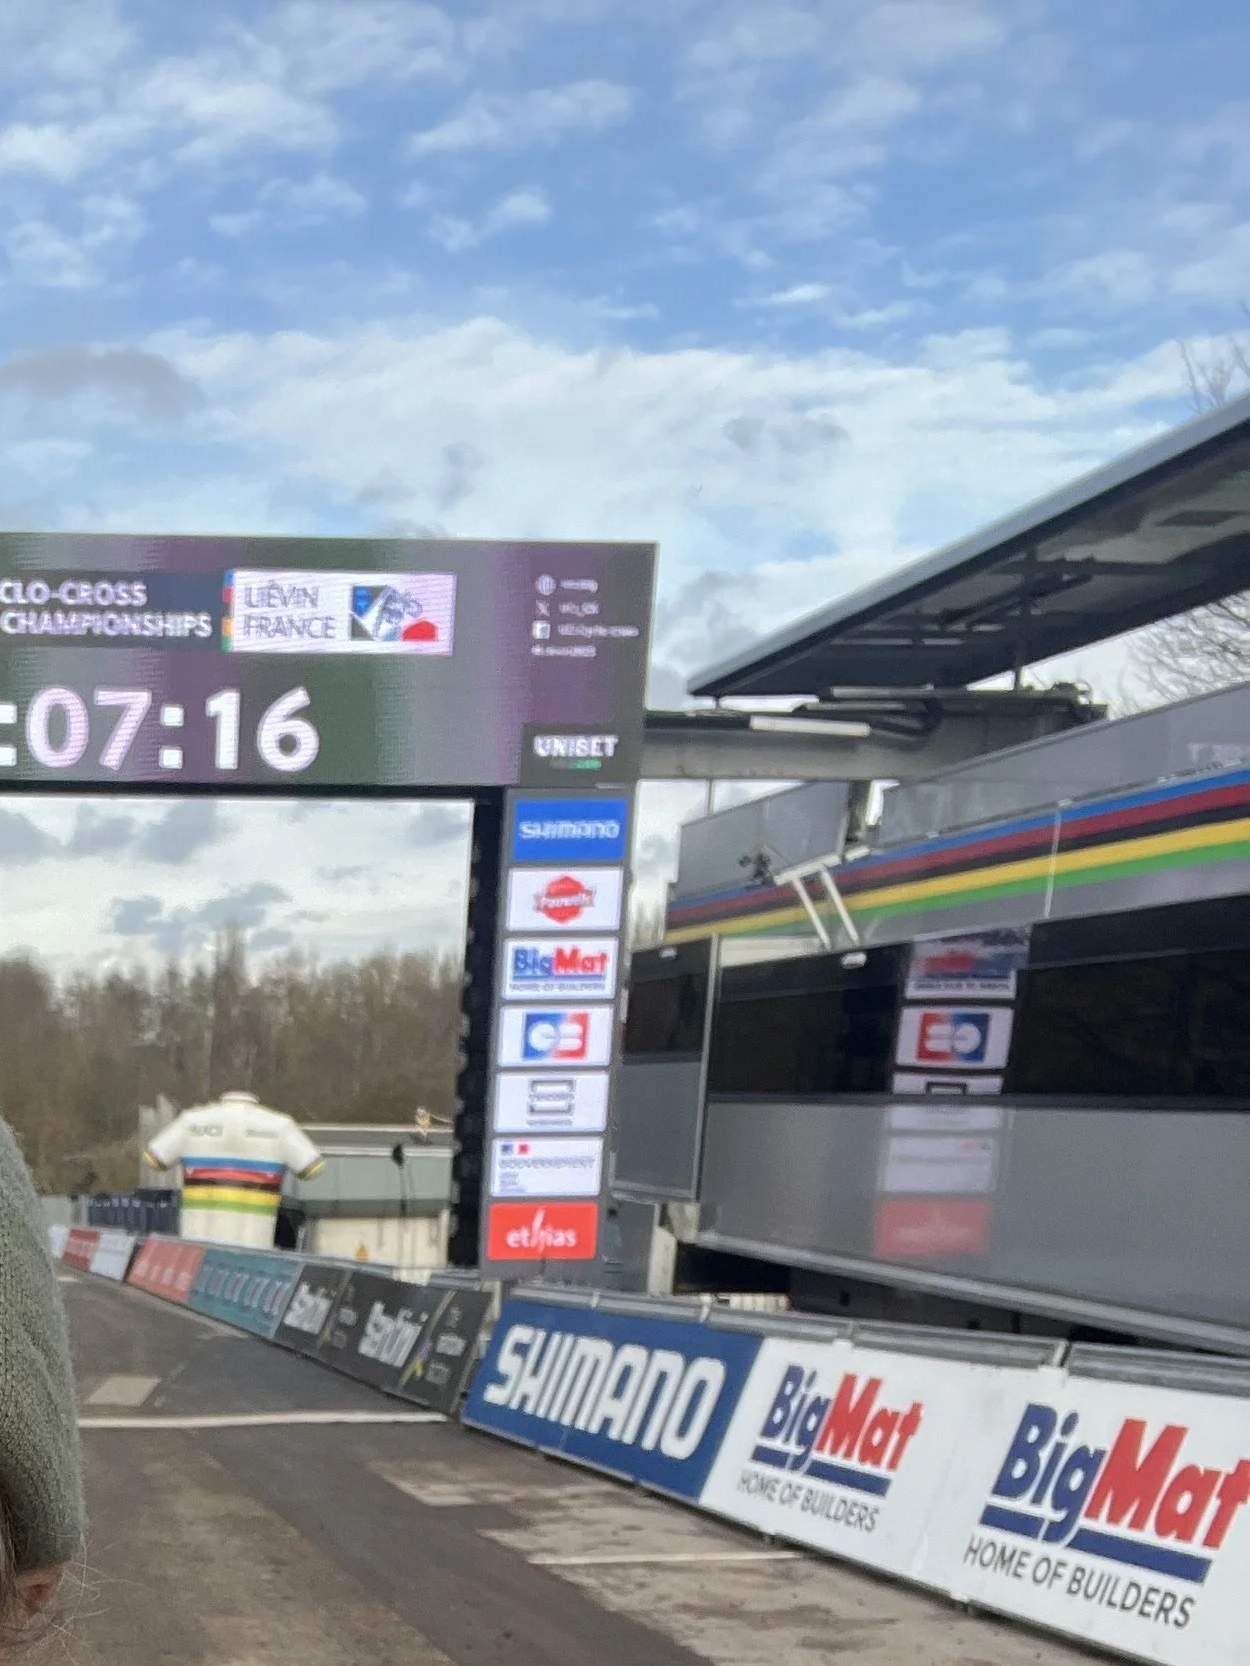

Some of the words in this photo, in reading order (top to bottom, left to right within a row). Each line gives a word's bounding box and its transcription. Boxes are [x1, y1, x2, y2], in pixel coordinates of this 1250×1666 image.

[244, 579, 319, 609] LIÉVIN
[1, 610, 213, 638] CHAMPIONSHIPS
[243, 615, 335, 640] FRANCE
[533, 735, 619, 757] UNIBET
[519, 819, 620, 840] SHIMANO
[513, 947, 608, 977] BigMat
[506, 1208, 577, 1252] ethias
[484, 1324, 726, 1460] SHIMANO
[760, 1365, 923, 1472] BigMat
[991, 1402, 1250, 1550] BigMat
[737, 1471, 780, 1502] HOME
[780, 1480, 803, 1509] OF
[801, 1483, 880, 1533] BUILDERS
[963, 1536, 1032, 1578] HOME
[1032, 1556, 1067, 1589] OF
[1067, 1566, 1196, 1628] BUILDERS
